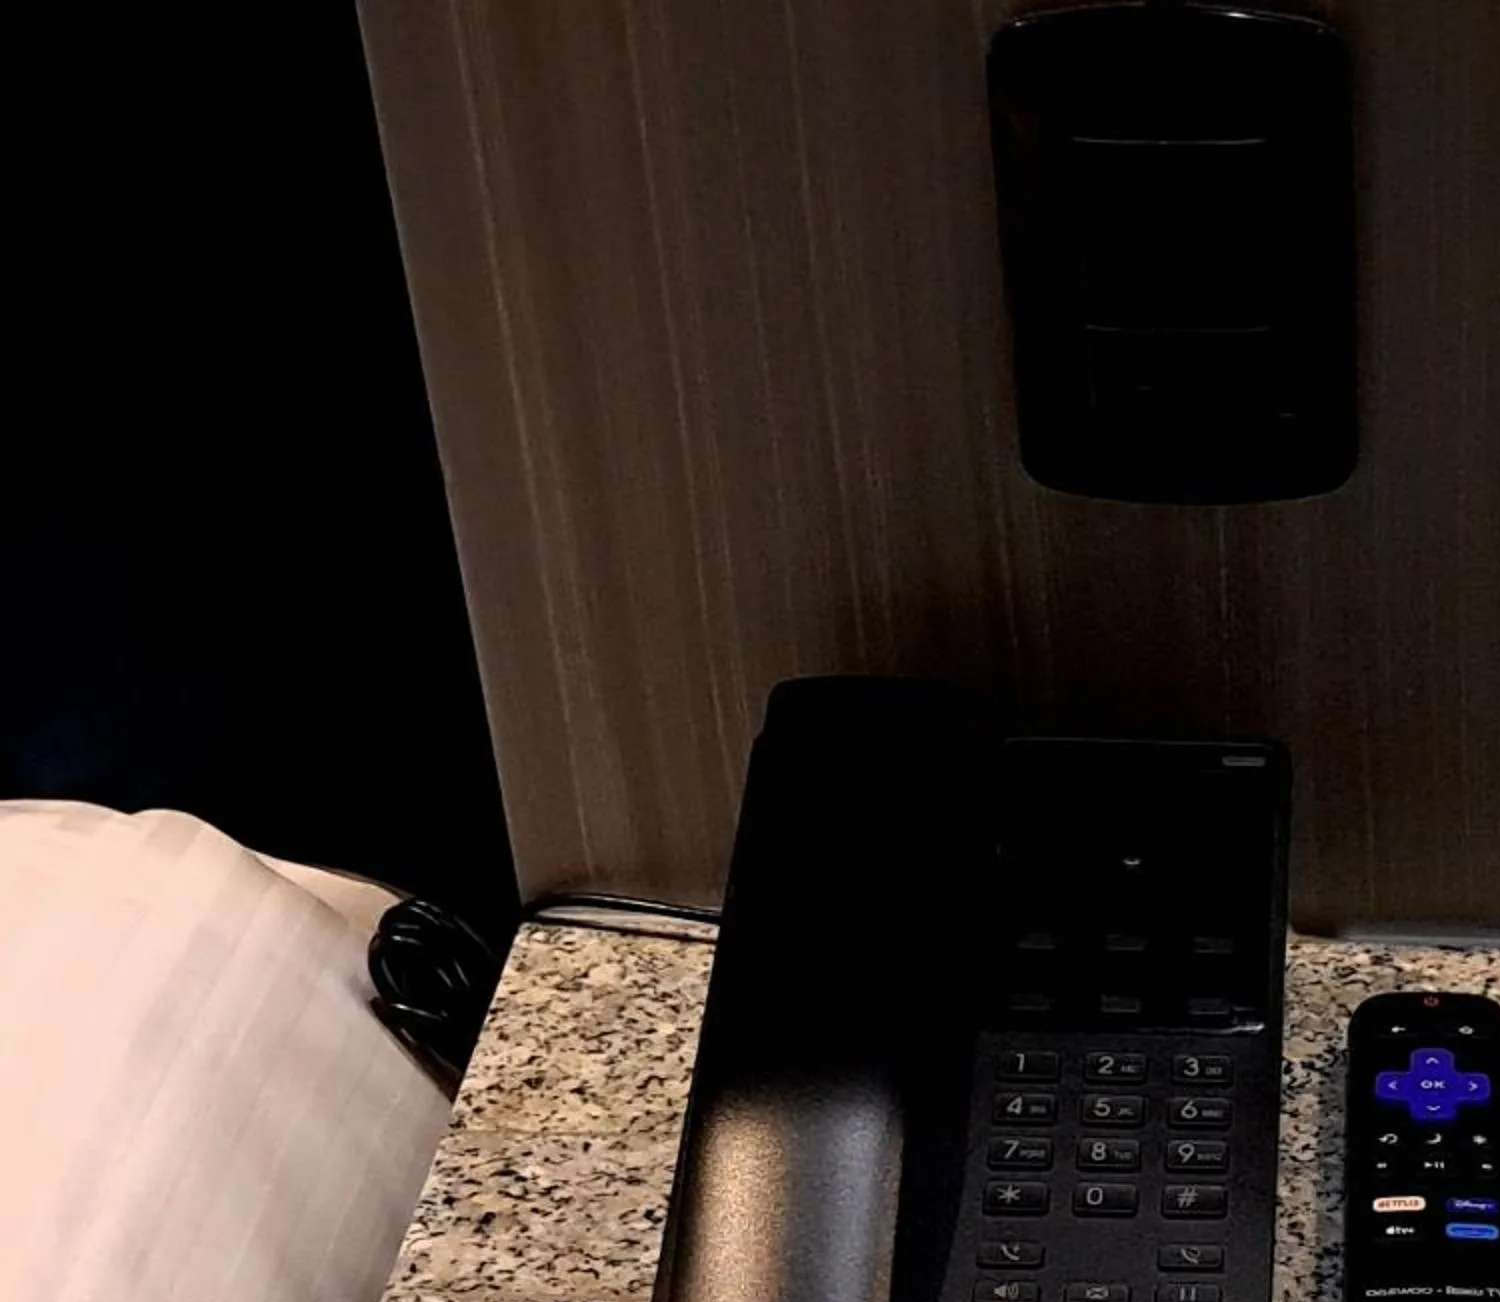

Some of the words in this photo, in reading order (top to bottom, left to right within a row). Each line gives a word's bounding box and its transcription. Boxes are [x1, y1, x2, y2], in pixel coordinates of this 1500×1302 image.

[1016, 1053, 1026, 1073] 1
[1098, 1055, 1115, 1075] 2
[1183, 1056, 1200, 1077] 3
[1420, 1079, 1447, 1089] OK
[1006, 1096, 1023, 1115] 4
[1093, 1098, 1111, 1117] 5
[1180, 1099, 1198, 1119] 6
[1003, 1139, 1020, 1160] 7
[1091, 1141, 1107, 1162] 8
[1177, 1143, 1195, 1164] 9
[1086, 1186, 1103, 1206] 0
[1176, 1184, 1199, 1208] #
